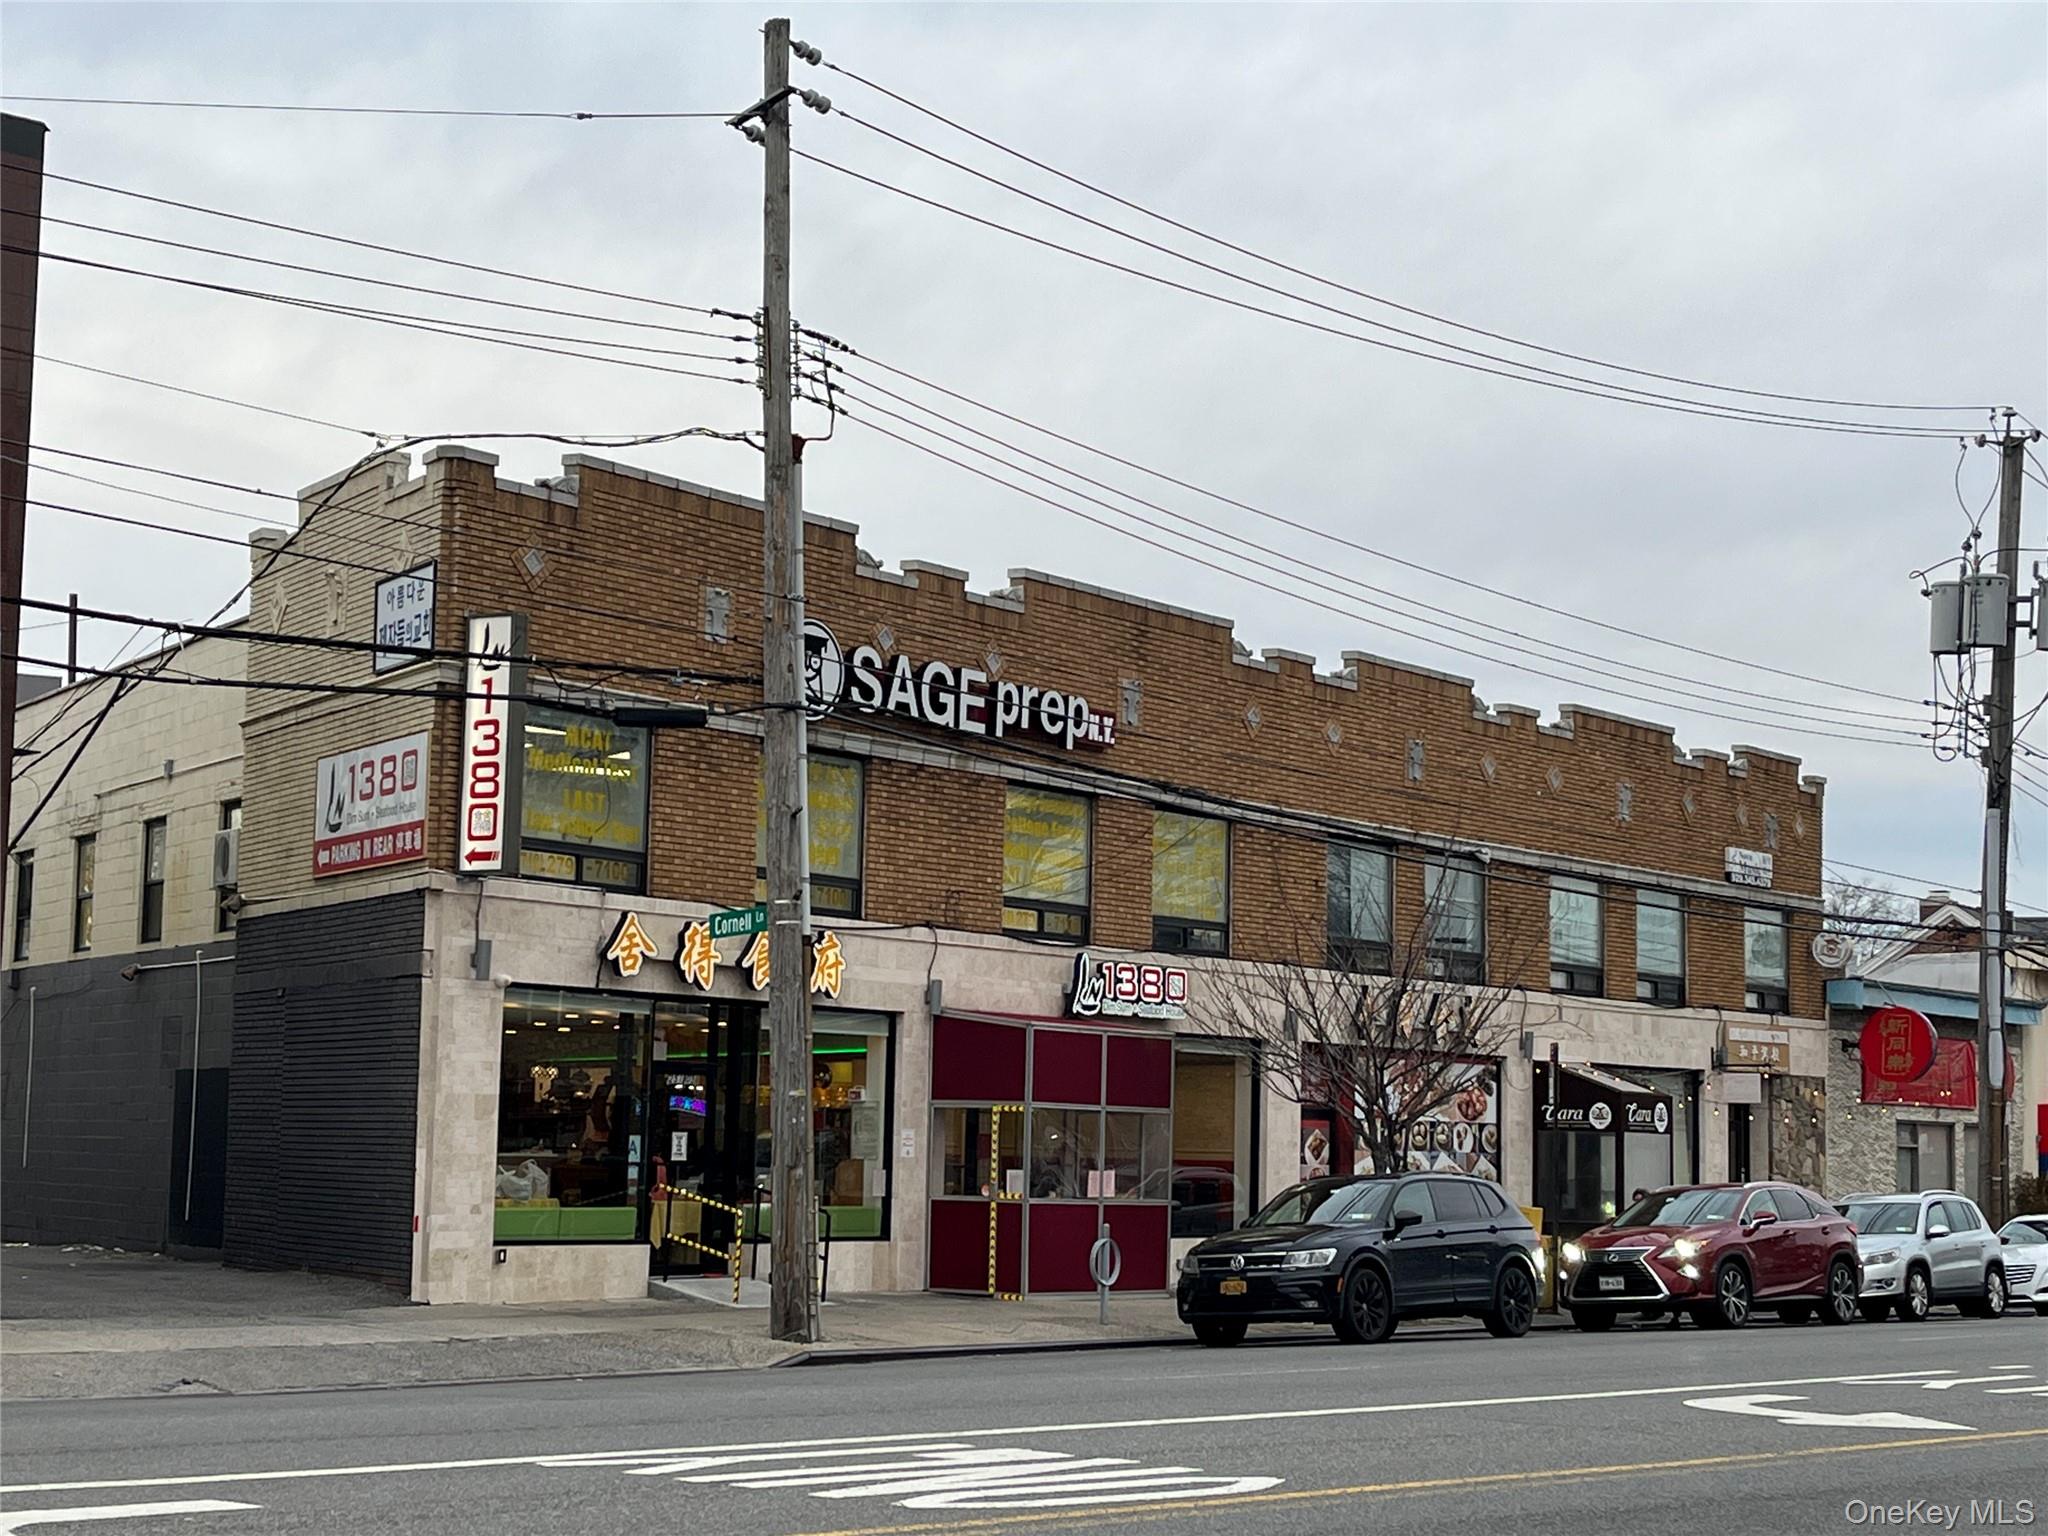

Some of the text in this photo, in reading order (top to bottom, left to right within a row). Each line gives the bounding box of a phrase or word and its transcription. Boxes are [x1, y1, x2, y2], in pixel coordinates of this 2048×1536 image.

[386, 580, 425, 612] 아름다운
[851, 645, 1116, 750] SAGE prep N.Y.
[349, 749, 418, 804] 1380
[467, 677, 500, 841] 1380
[331, 840, 361, 865] PARKING
[363, 838, 372, 859] IN
[372, 833, 394, 857] REAR
[714, 911, 765, 935] Cornell Ln
[1102, 962, 1188, 1003] 1380
